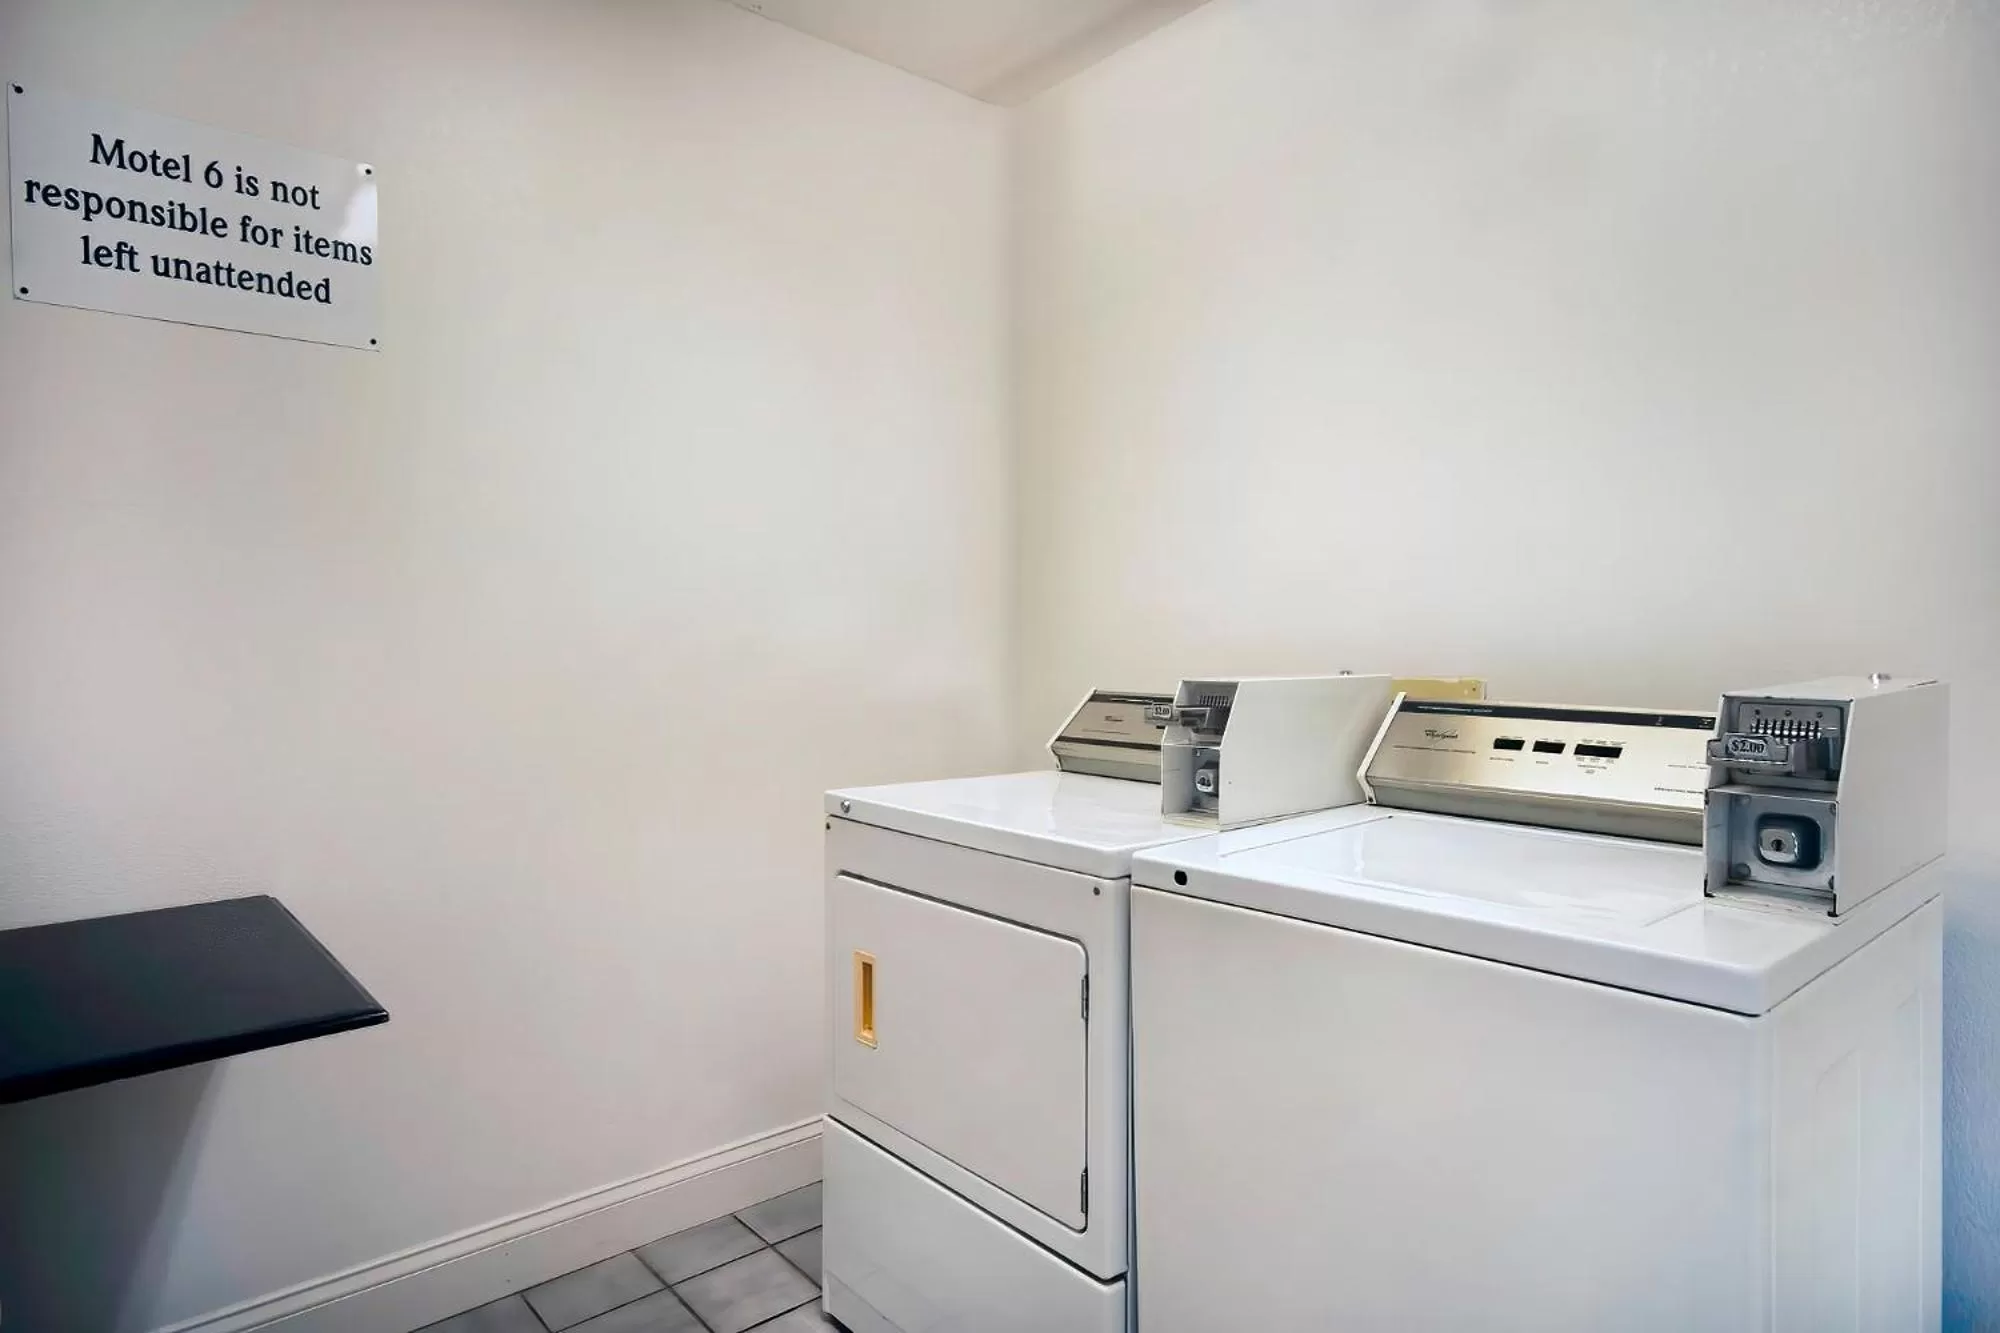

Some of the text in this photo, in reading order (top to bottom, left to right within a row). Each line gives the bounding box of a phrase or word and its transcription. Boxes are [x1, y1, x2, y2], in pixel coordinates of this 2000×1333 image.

[89, 132, 321, 210] Motel 6 is not
[23, 179, 373, 266] responsible for items
[80, 234, 332, 305] left unattended
[1731, 739, 1765, 753] $2.00
